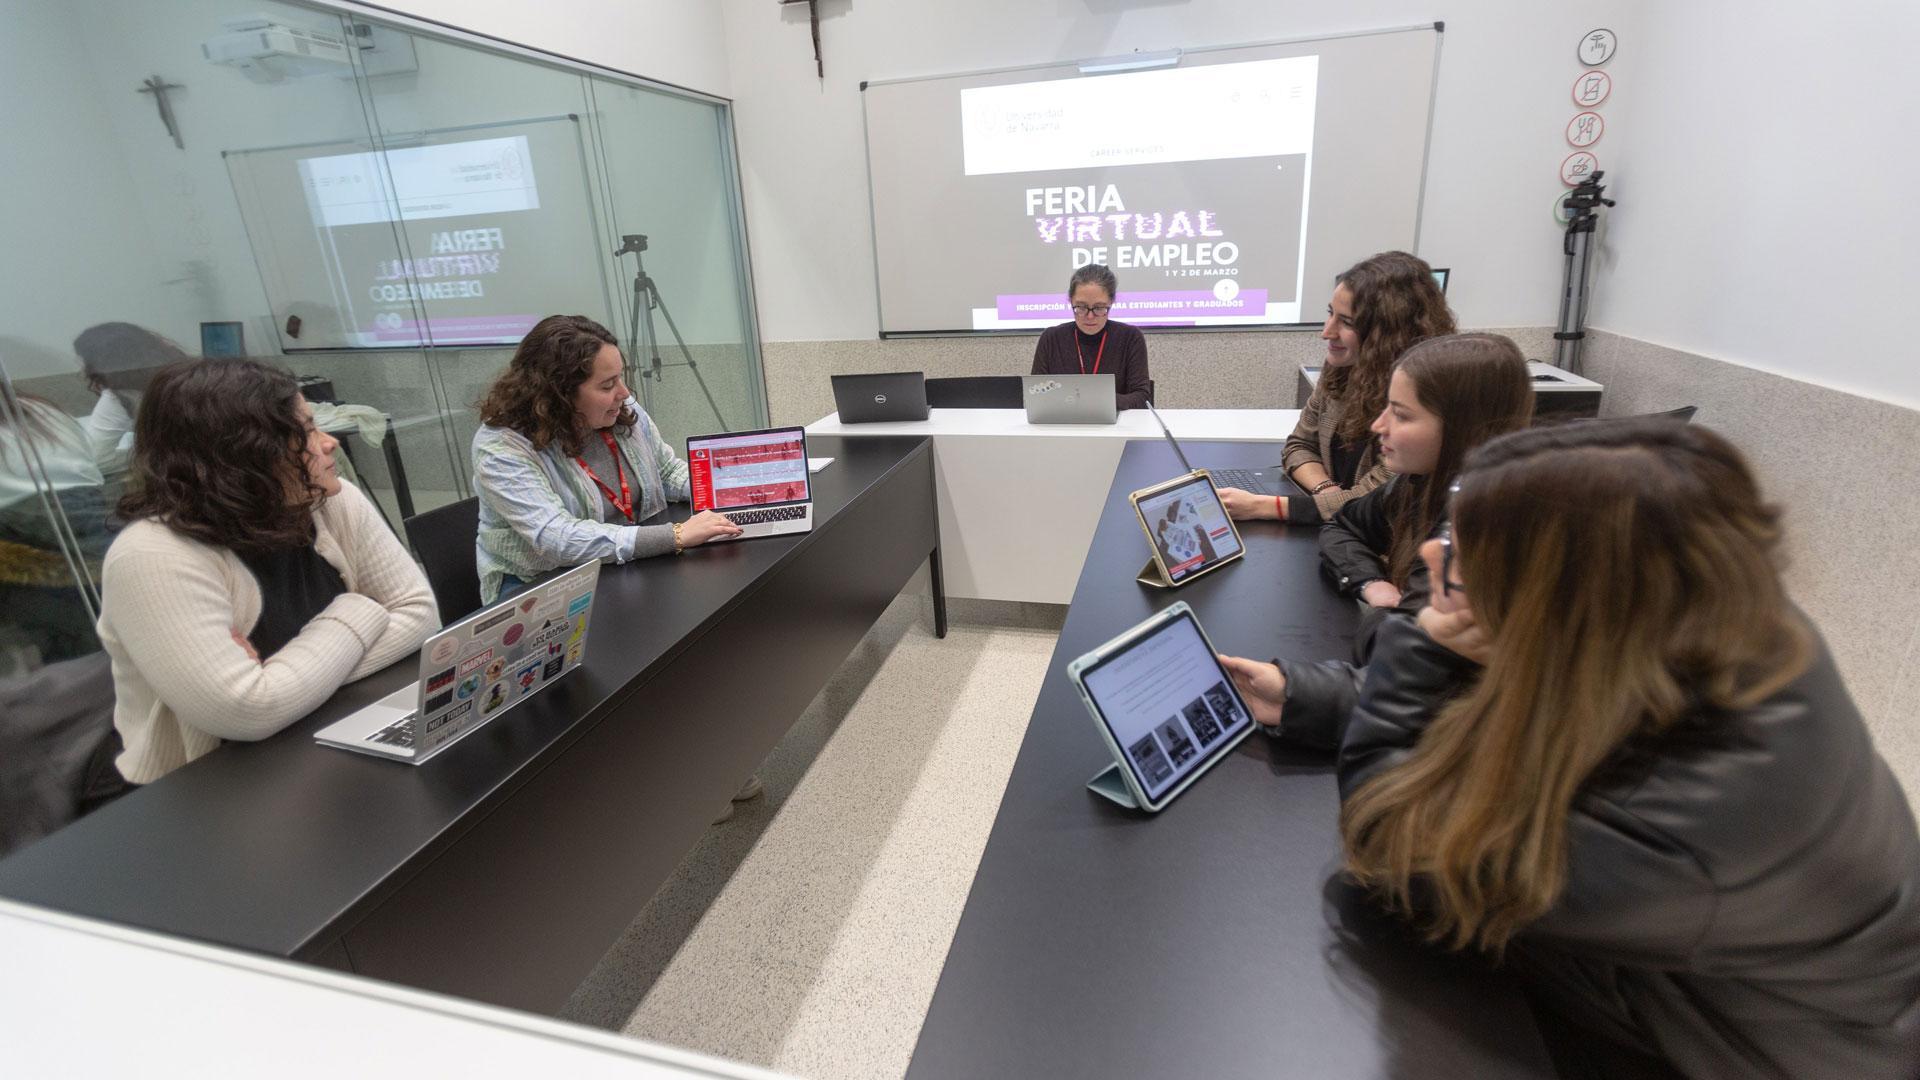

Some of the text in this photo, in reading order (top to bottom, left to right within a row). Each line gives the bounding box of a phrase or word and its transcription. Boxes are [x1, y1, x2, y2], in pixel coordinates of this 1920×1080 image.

[1026, 184, 1126, 216] FERIA
[1035, 210, 1224, 243] VIRTUAL
[1072, 241, 1239, 269] DE EMPLEO
[1204, 268, 1239, 276] MARZO
[1016, 303, 1065, 312] INSCRIPCIÓN
[1111, 302, 1127, 310] ARA
[1129, 300, 1184, 309] ESTUDIANTES
[1186, 300, 1192, 308] Y
[1193, 299, 1244, 308] GRADUADOS
[461, 650, 491, 674] MARVEL
[429, 715, 445, 731] NOT
[447, 701, 472, 720] TODAY
